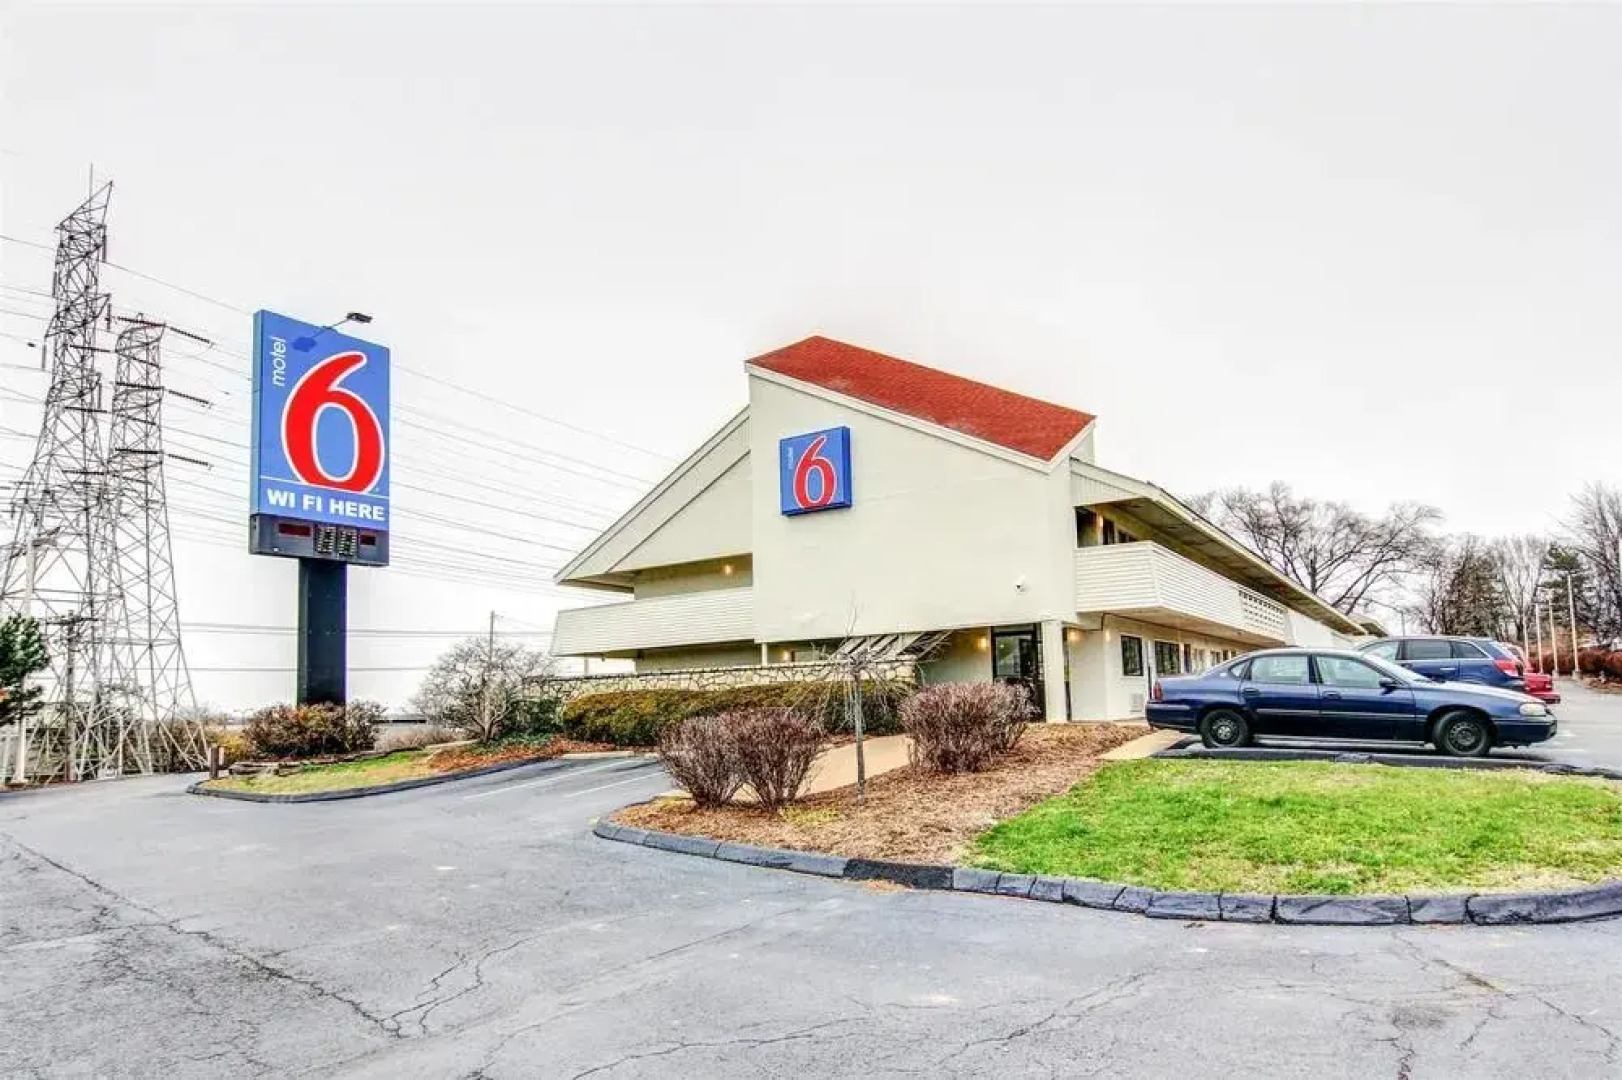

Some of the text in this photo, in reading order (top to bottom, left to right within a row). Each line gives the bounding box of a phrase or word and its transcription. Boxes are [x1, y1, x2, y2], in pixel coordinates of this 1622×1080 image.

[271, 336, 287, 387] motel
[281, 351, 385, 494] 6
[793, 435, 837, 509] 6
[267, 488, 386, 521] WI FI HERE
